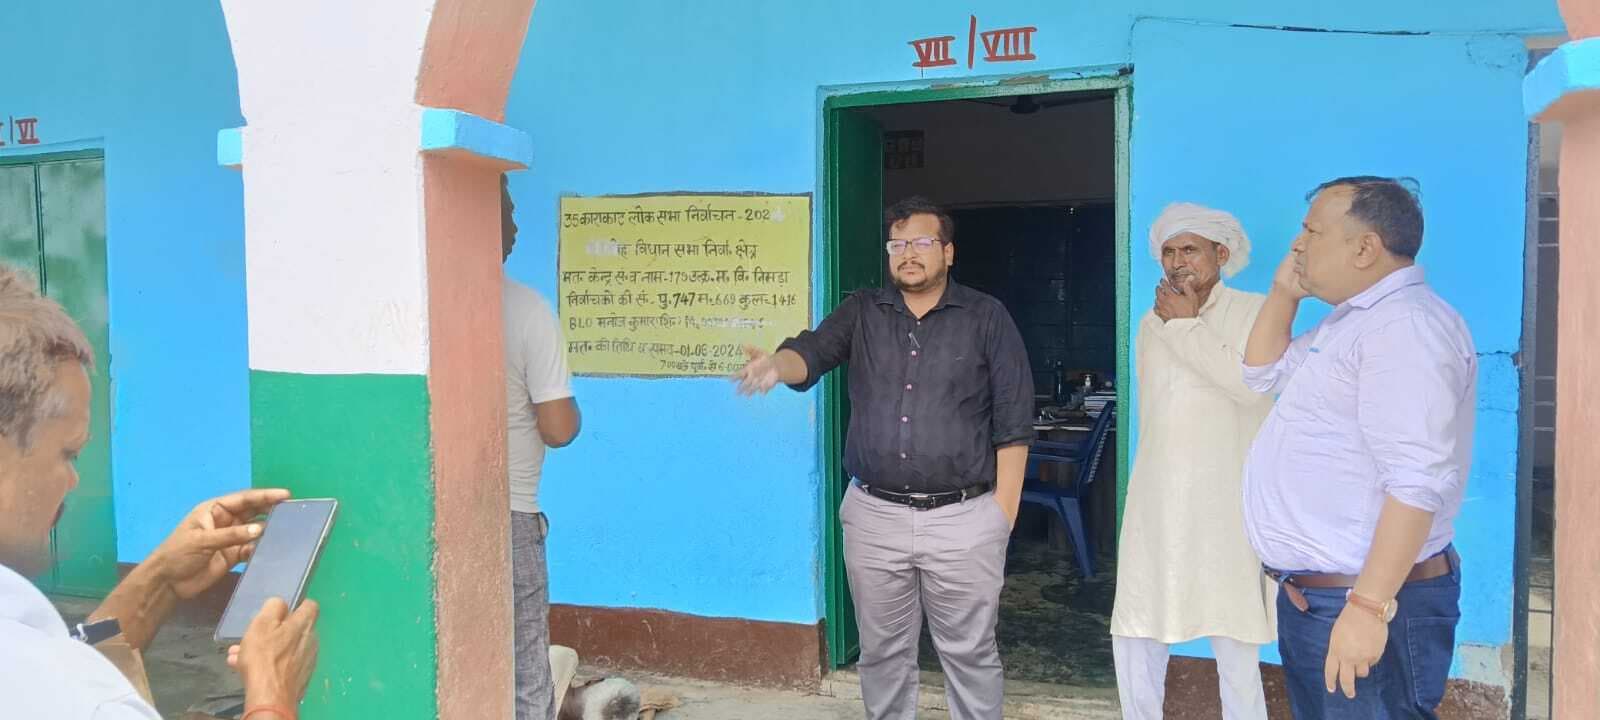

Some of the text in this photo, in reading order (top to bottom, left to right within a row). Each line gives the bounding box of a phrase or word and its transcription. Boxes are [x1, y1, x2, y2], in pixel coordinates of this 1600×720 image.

[907, 36, 957, 67] VII
[980, 26, 1037, 61] VIII
[744, 207, 784, 224] 202
